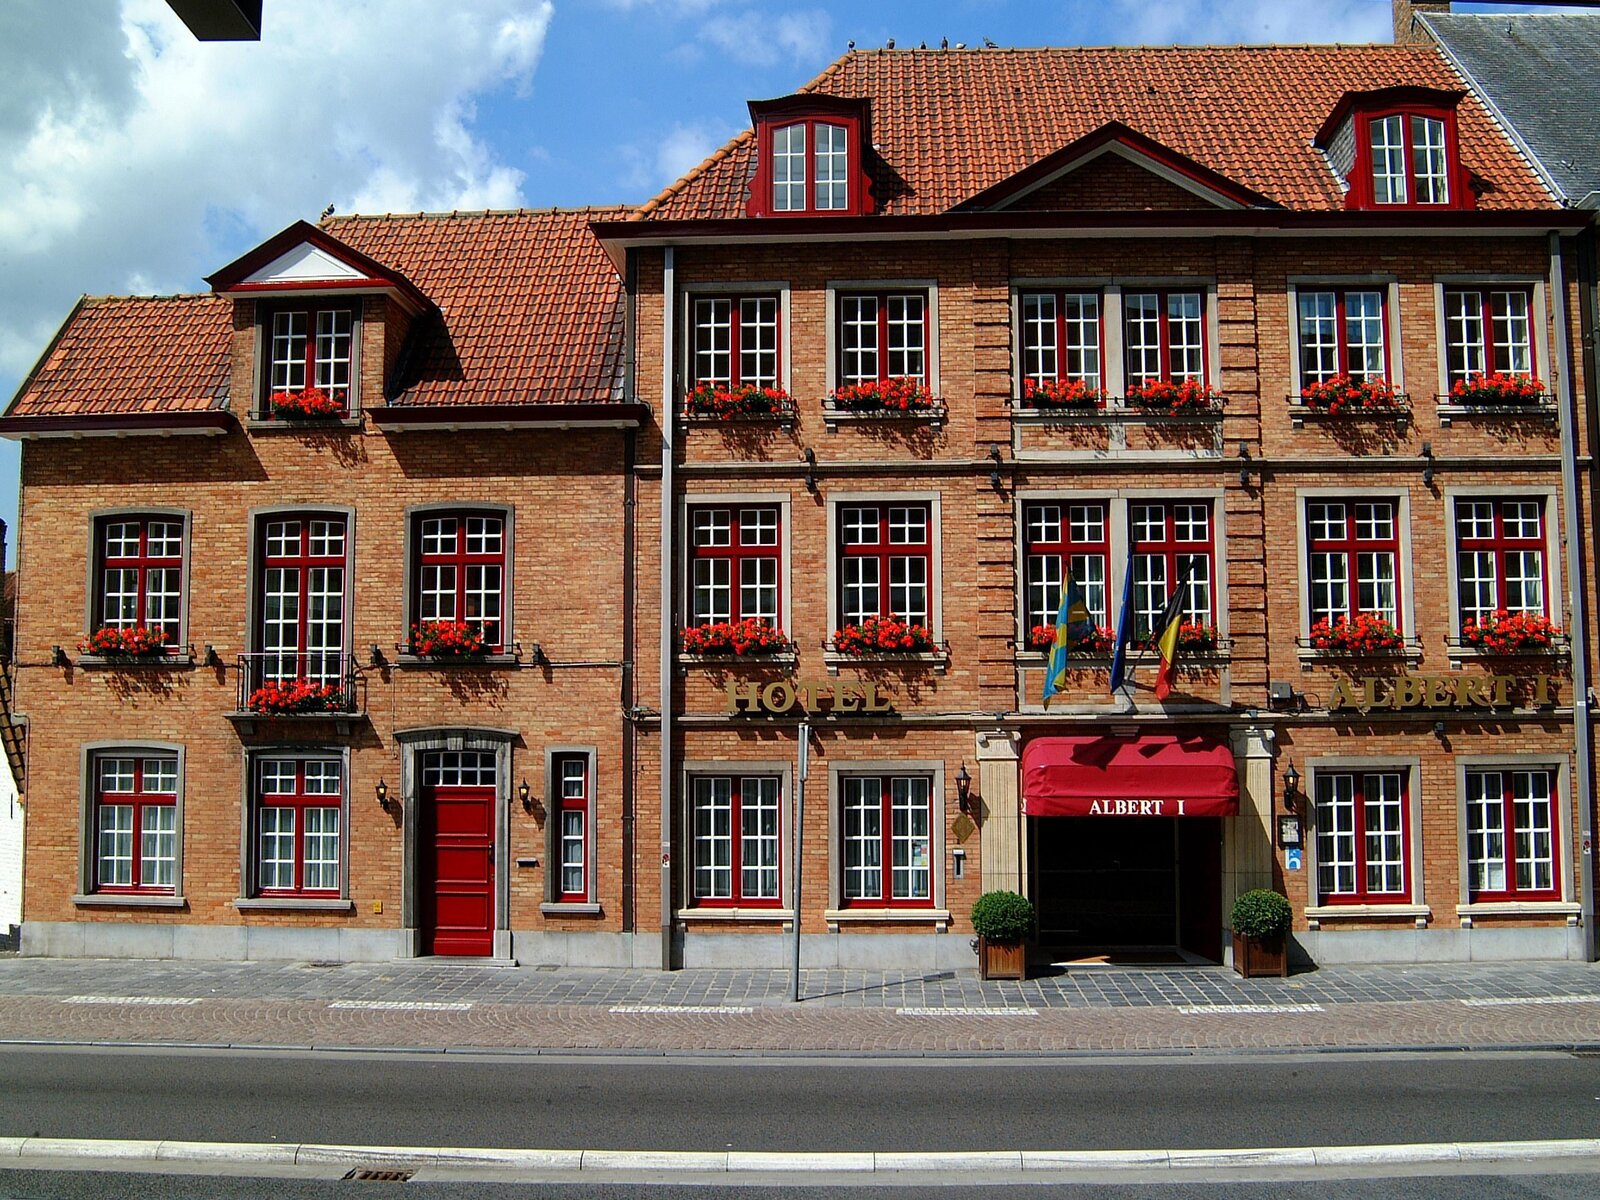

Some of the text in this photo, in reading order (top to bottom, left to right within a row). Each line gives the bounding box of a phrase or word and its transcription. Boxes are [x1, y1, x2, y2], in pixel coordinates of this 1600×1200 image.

[725, 680, 891, 713] HOTEL
[1327, 674, 1552, 708] ALBERT I
[1089, 799, 1186, 815] ALBERT I
